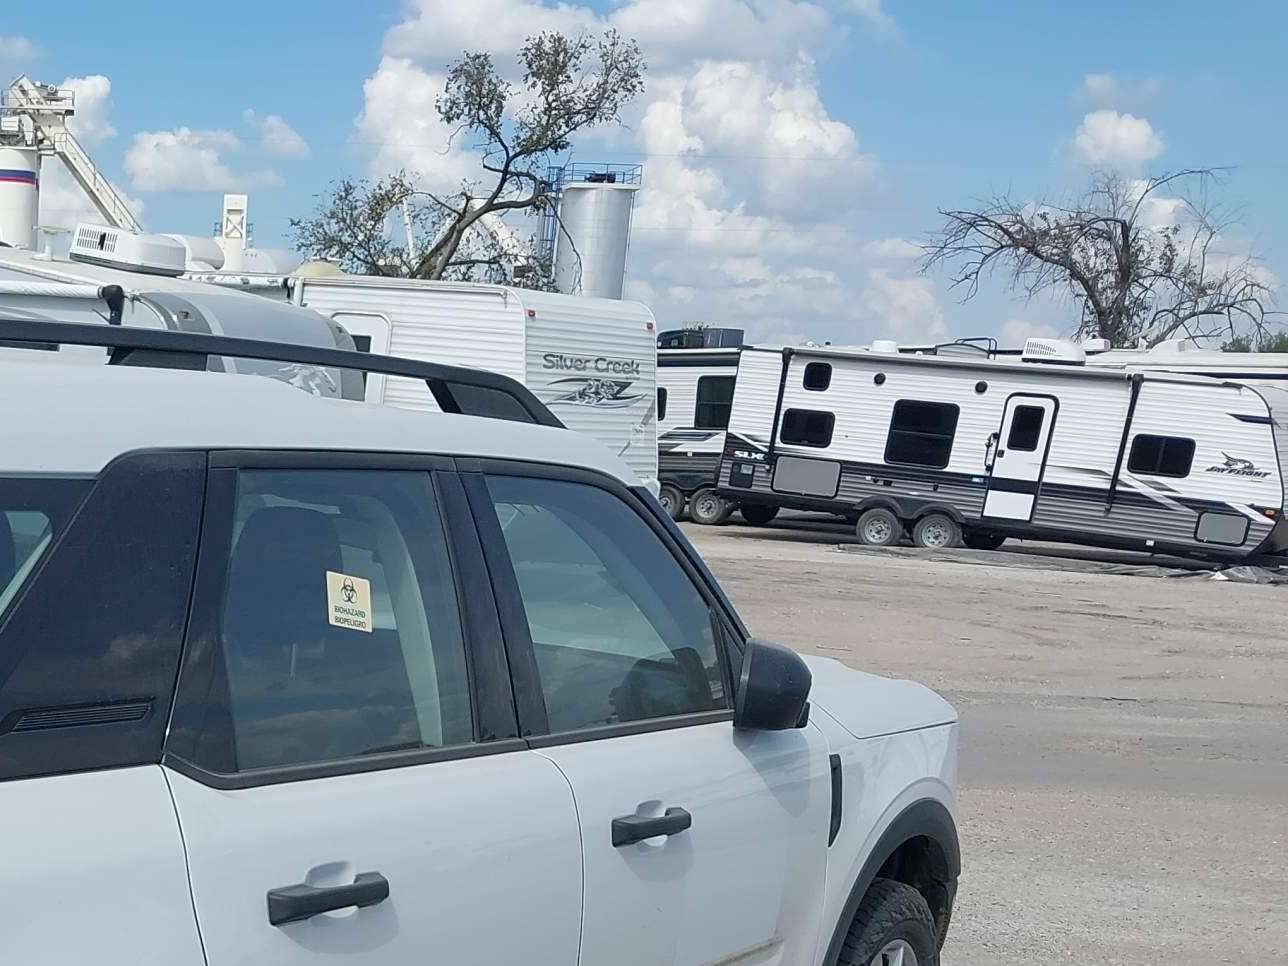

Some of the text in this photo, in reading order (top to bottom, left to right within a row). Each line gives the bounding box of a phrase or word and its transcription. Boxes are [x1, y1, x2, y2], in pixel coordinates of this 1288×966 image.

[542, 353, 641, 375] Silver Creek
[334, 605, 366, 618] BIOHAZARD
[334, 616, 367, 628] BIOPELIGRO
